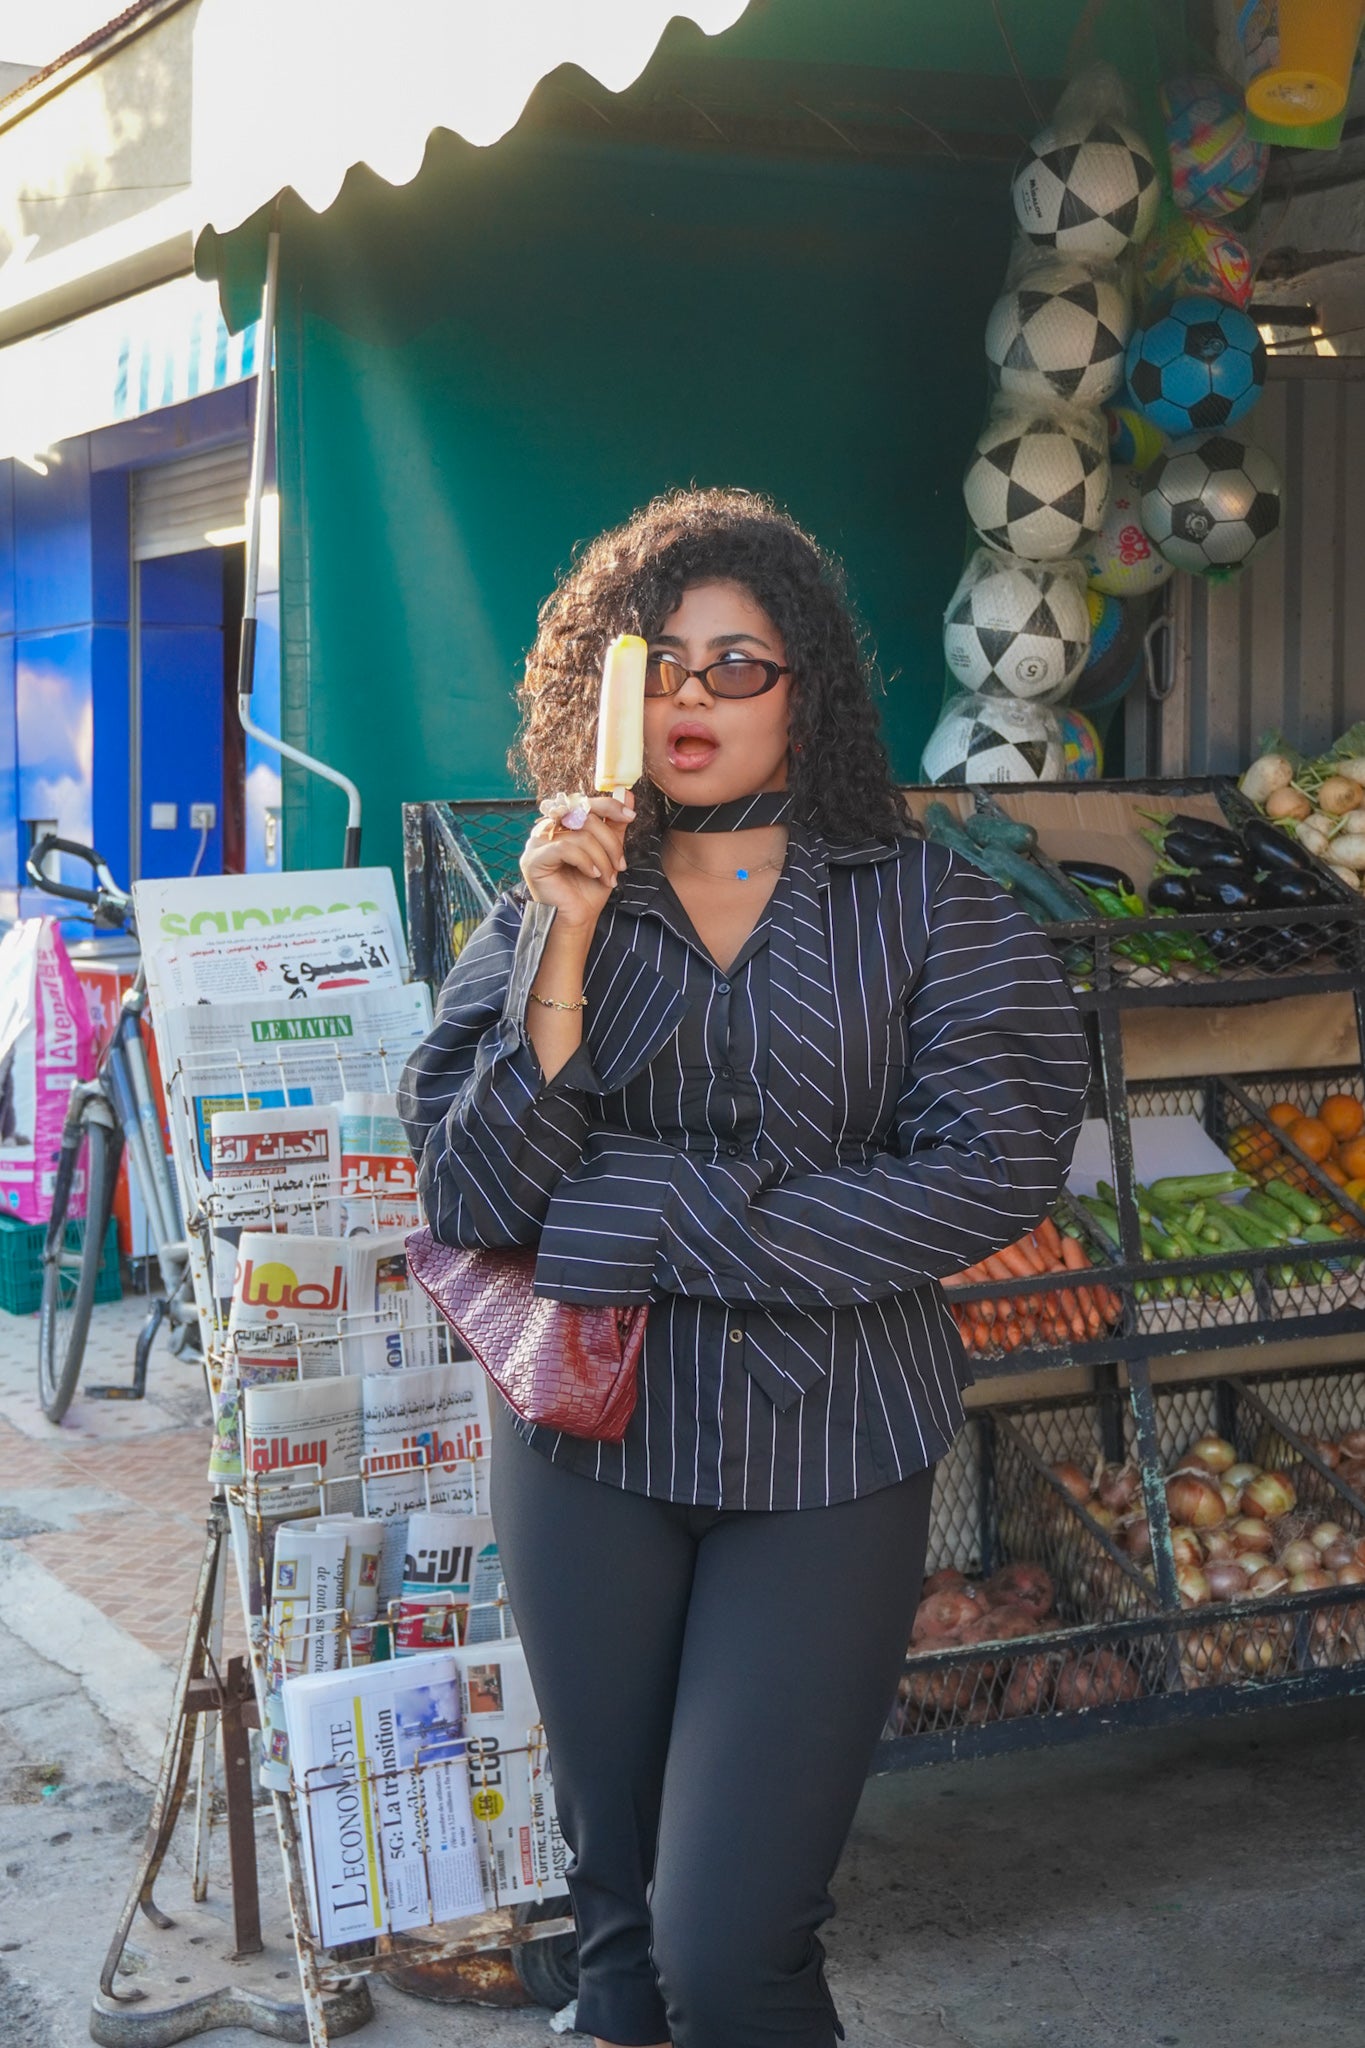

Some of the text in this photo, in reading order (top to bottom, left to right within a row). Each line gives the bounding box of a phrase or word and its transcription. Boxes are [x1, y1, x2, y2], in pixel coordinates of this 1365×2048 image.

[279, 939, 390, 985] الأسبوع
[254, 1022, 283, 1041] LE
[254, 1130, 329, 1162] الأحداث
[273, 1179, 304, 1192] محمد
[252, 1437, 327, 1471] رسالة
[317, 1566, 330, 1581] de
[375, 1708, 399, 1798] transition
[383, 1801, 403, 1828] La
[389, 1830, 406, 1861] 5G:
